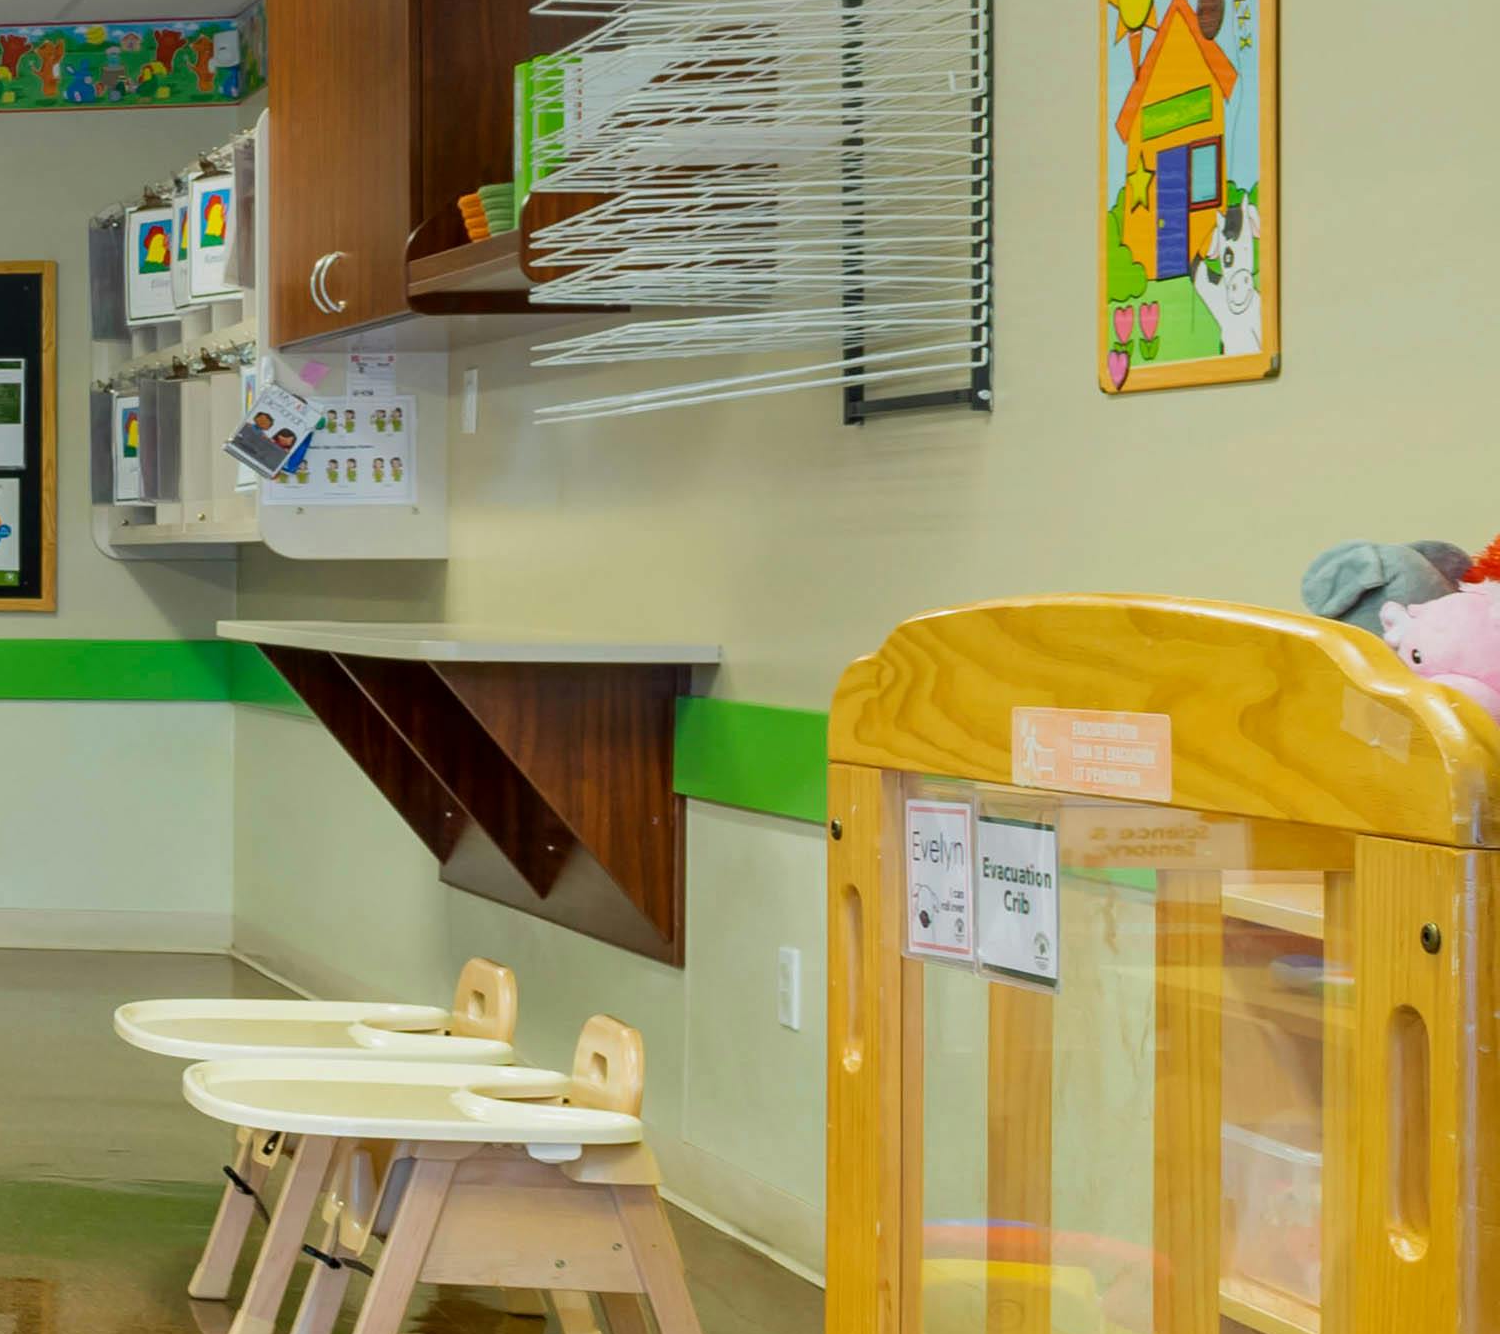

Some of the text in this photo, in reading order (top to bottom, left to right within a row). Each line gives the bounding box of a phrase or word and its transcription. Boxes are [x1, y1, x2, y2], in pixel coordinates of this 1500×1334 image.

[912, 830, 966, 873] Evelyn
[982, 856, 1053, 890] Evacuation
[1003, 890, 1031, 915] Crib
